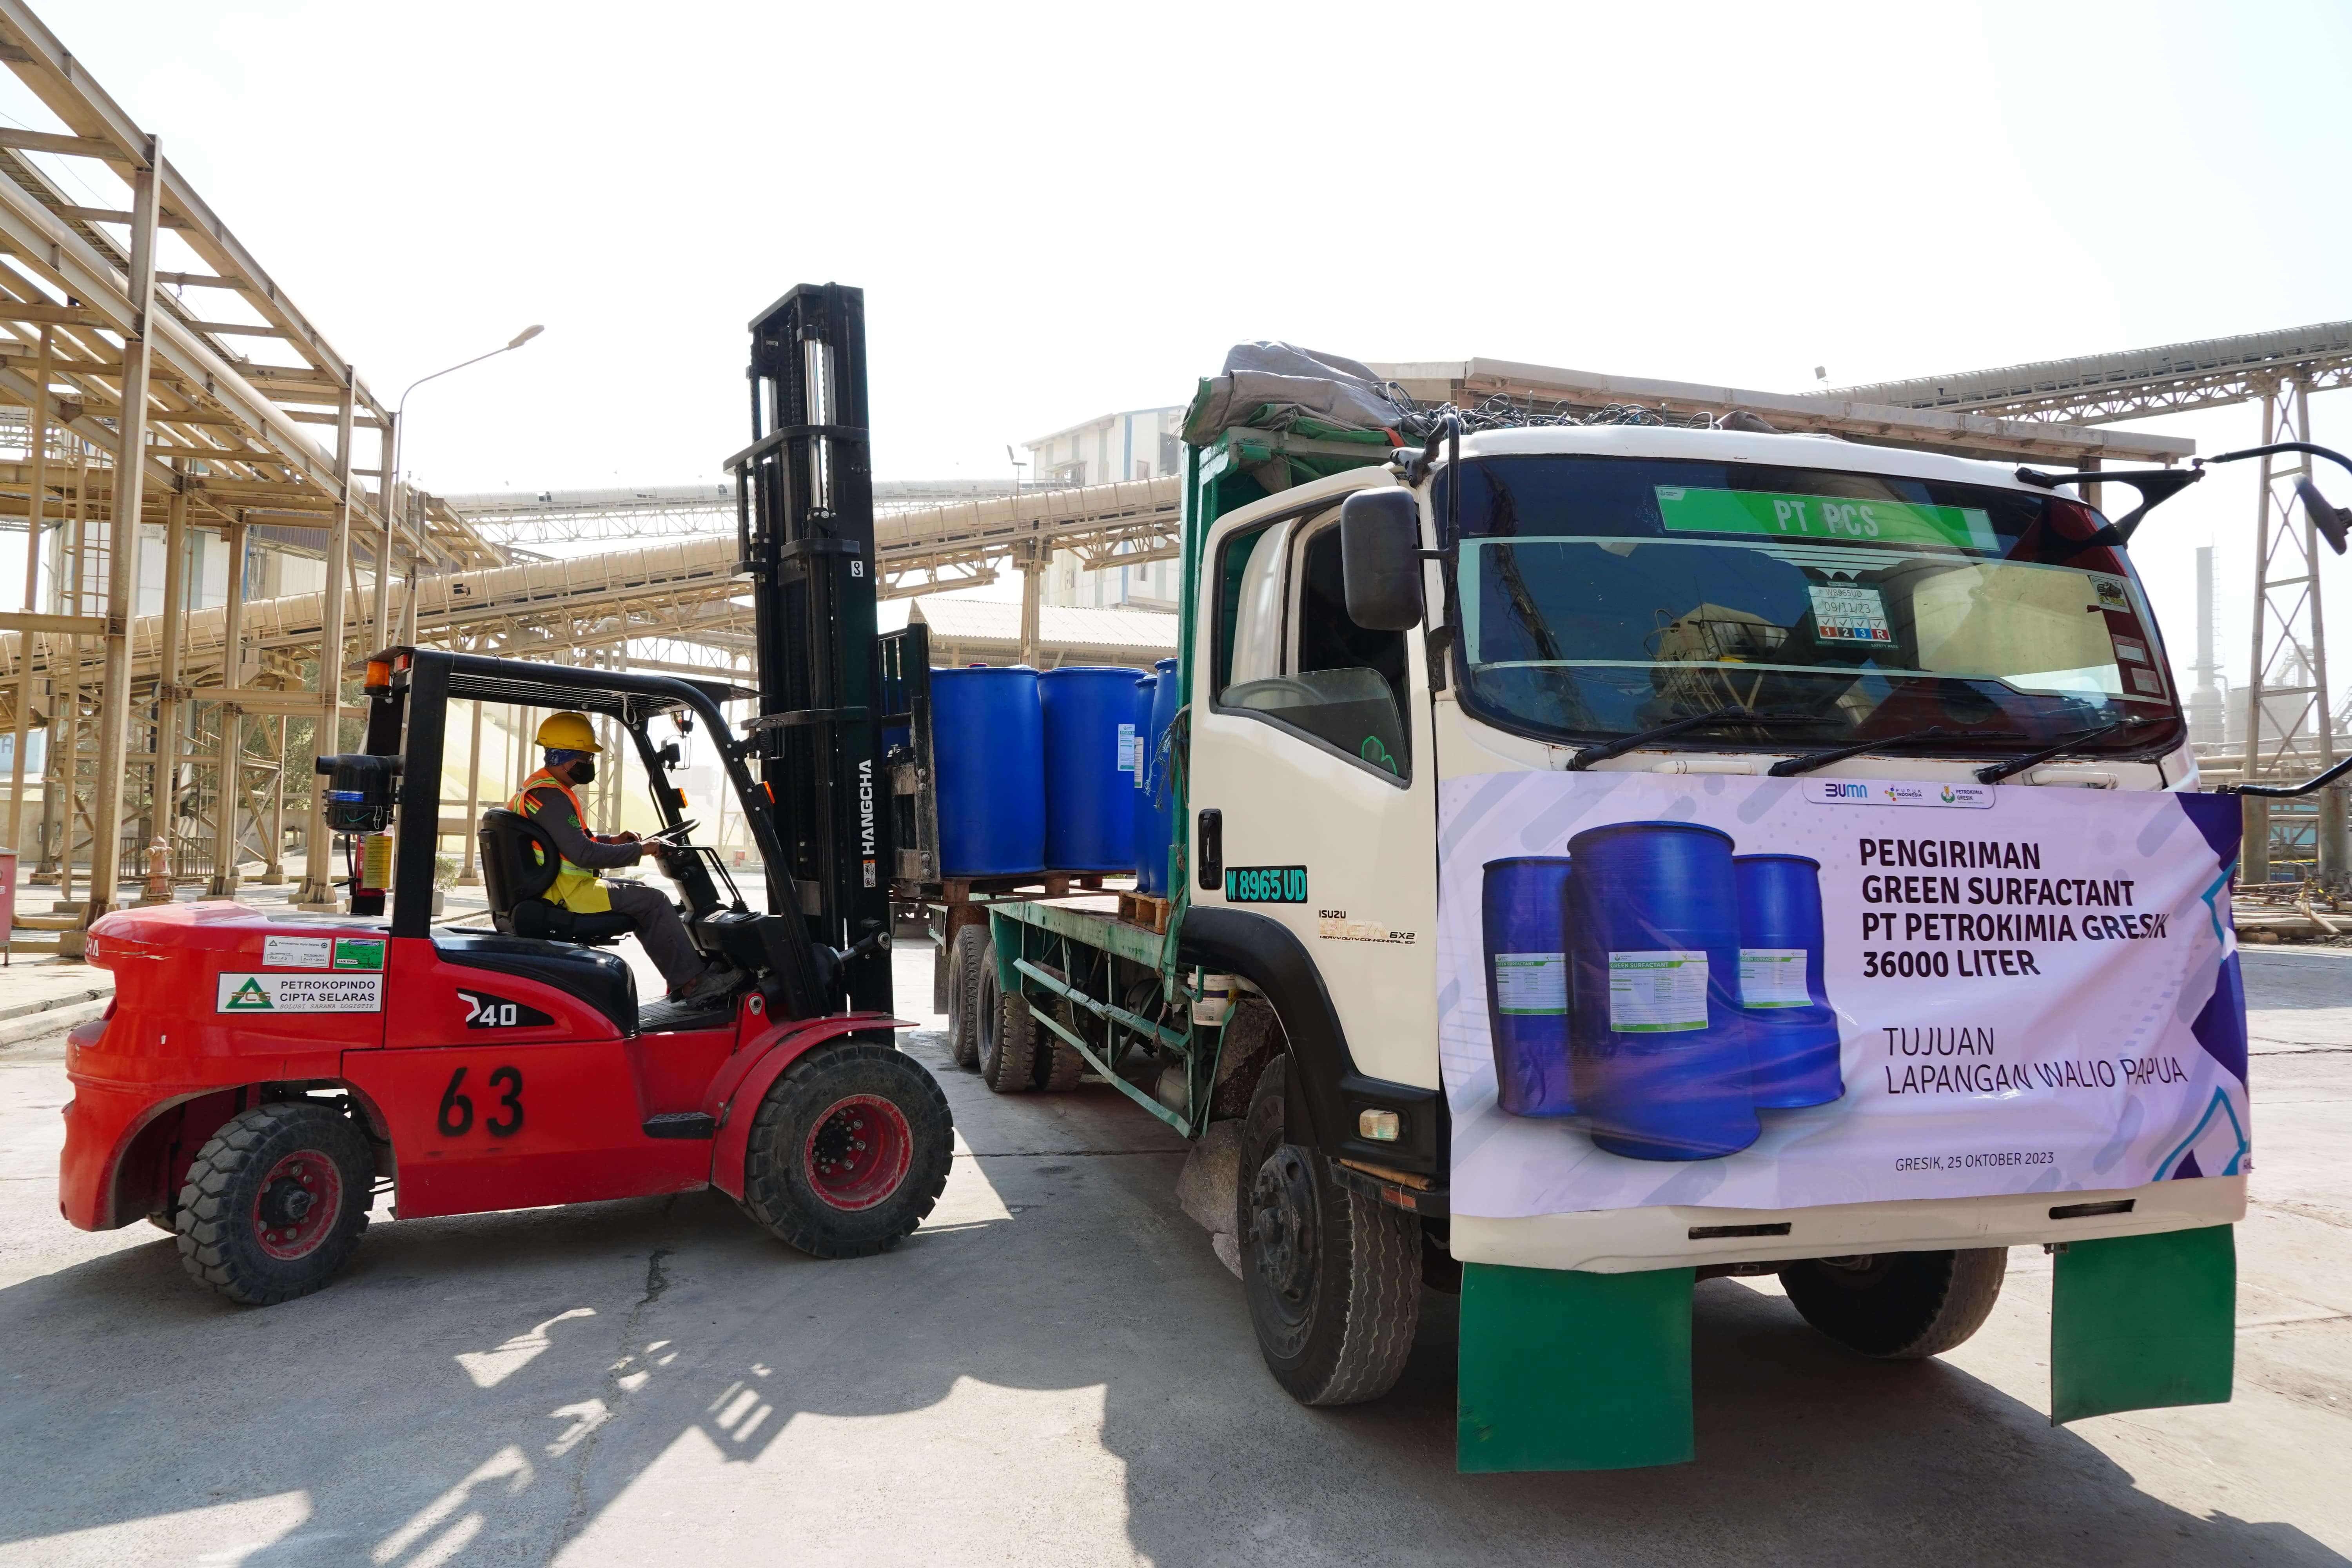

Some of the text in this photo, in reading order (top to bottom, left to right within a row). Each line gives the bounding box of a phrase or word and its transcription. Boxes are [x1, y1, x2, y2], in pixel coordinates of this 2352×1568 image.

[1773, 500, 1879, 537] PT PCS
[1824, 602, 1871, 613] 09/11/23
[1842, 628, 1849, 636] 2
[1860, 629, 1866, 637] 3
[1876, 630, 1885, 638] R
[859, 759, 875, 855] HANGCHA
[1860, 838, 2040, 869] PENGIRIMAN
[1227, 869, 1306, 900] W 8965 UD
[1862, 875, 2134, 906] GREEN SURFACTANT
[1319, 910, 1346, 918] ISUZU
[1863, 913, 2170, 941] PT PETROKIMIA GRESIK
[1863, 950, 2041, 977] 36000 LITER
[280, 993, 375, 1002] CIPTA SELARAS
[281, 981, 375, 989] PETROKOPINDO
[1882, 1027, 1994, 1056] TUJUAN
[1886, 1057, 2189, 1094] LAPANGAN WALIO PAPUA
[438, 1066, 524, 1137] 63
[1896, 1152, 2054, 1171] GRESIK, 25 OKTOBER 2023
